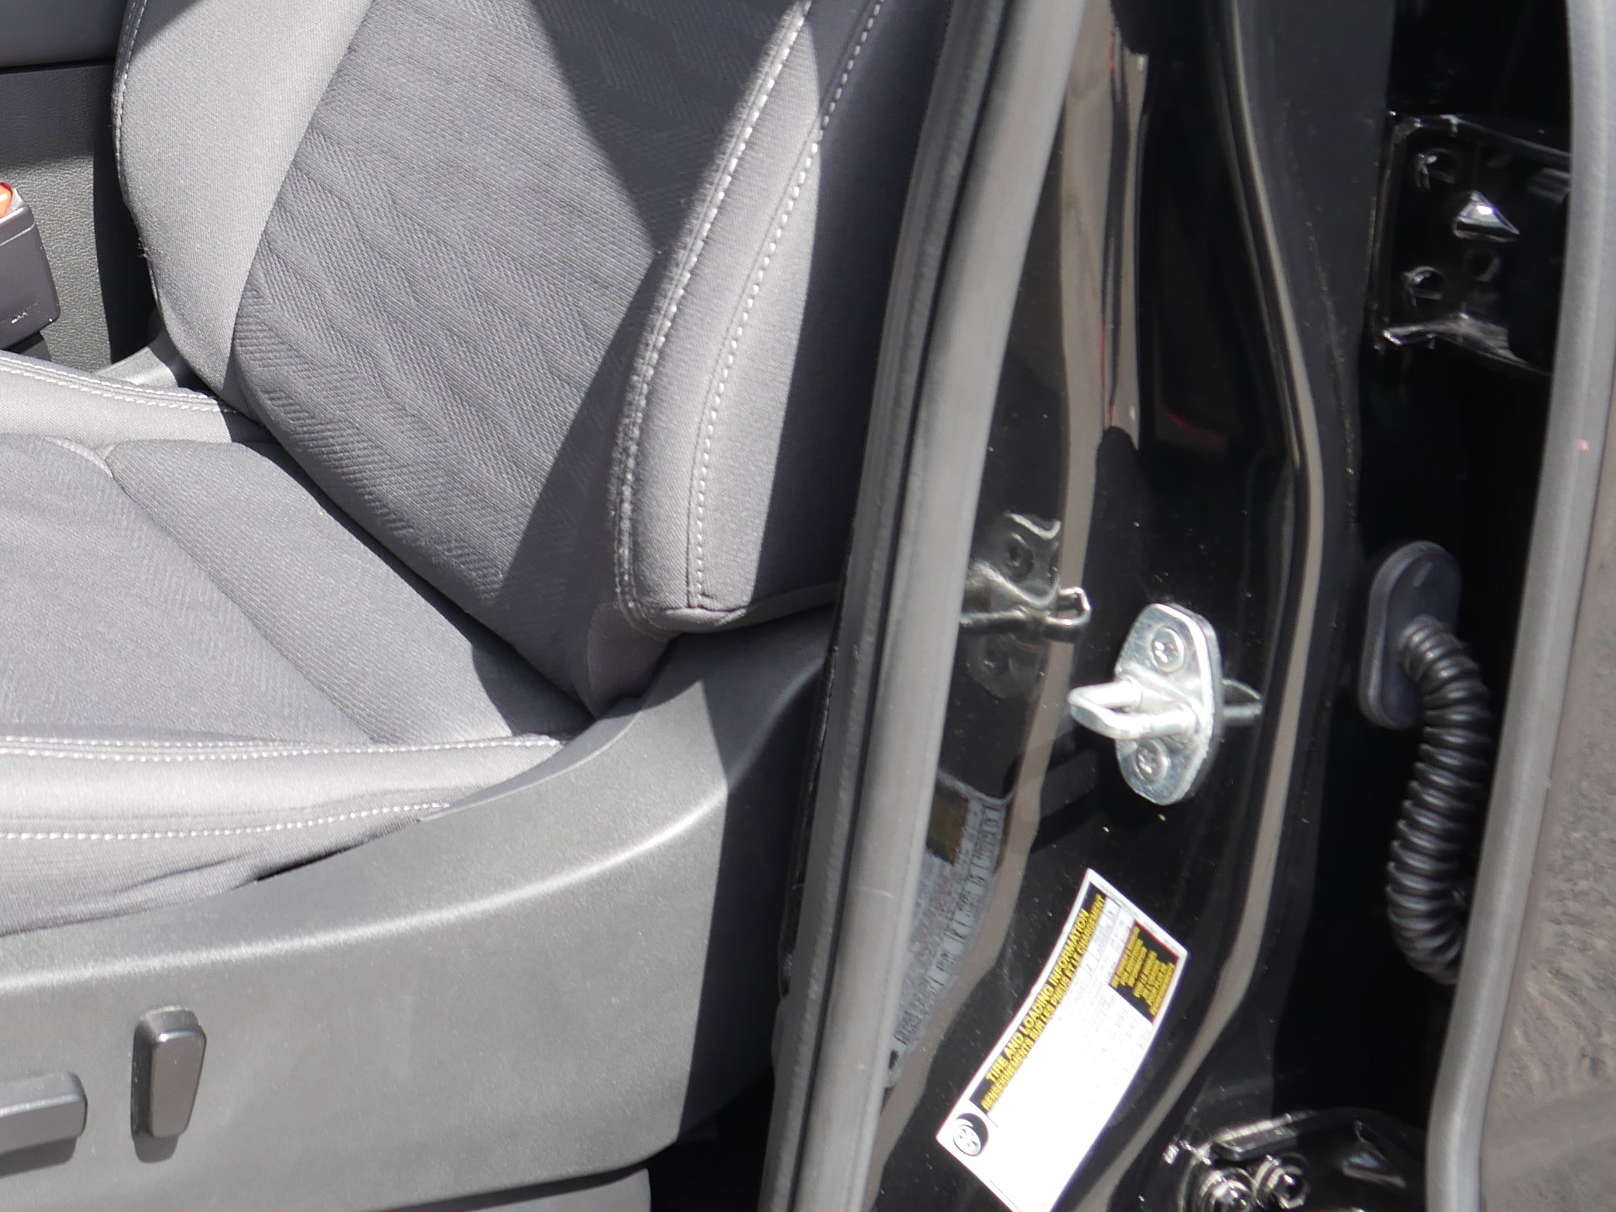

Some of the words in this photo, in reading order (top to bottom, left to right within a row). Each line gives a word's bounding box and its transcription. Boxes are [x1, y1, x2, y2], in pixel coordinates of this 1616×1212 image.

[985, 1054, 1009, 1082] TIRE
[1002, 1031, 1025, 1059] AND
[1018, 982, 1055, 1035] LOADING
[1048, 908, 1089, 985] INFORMATION
